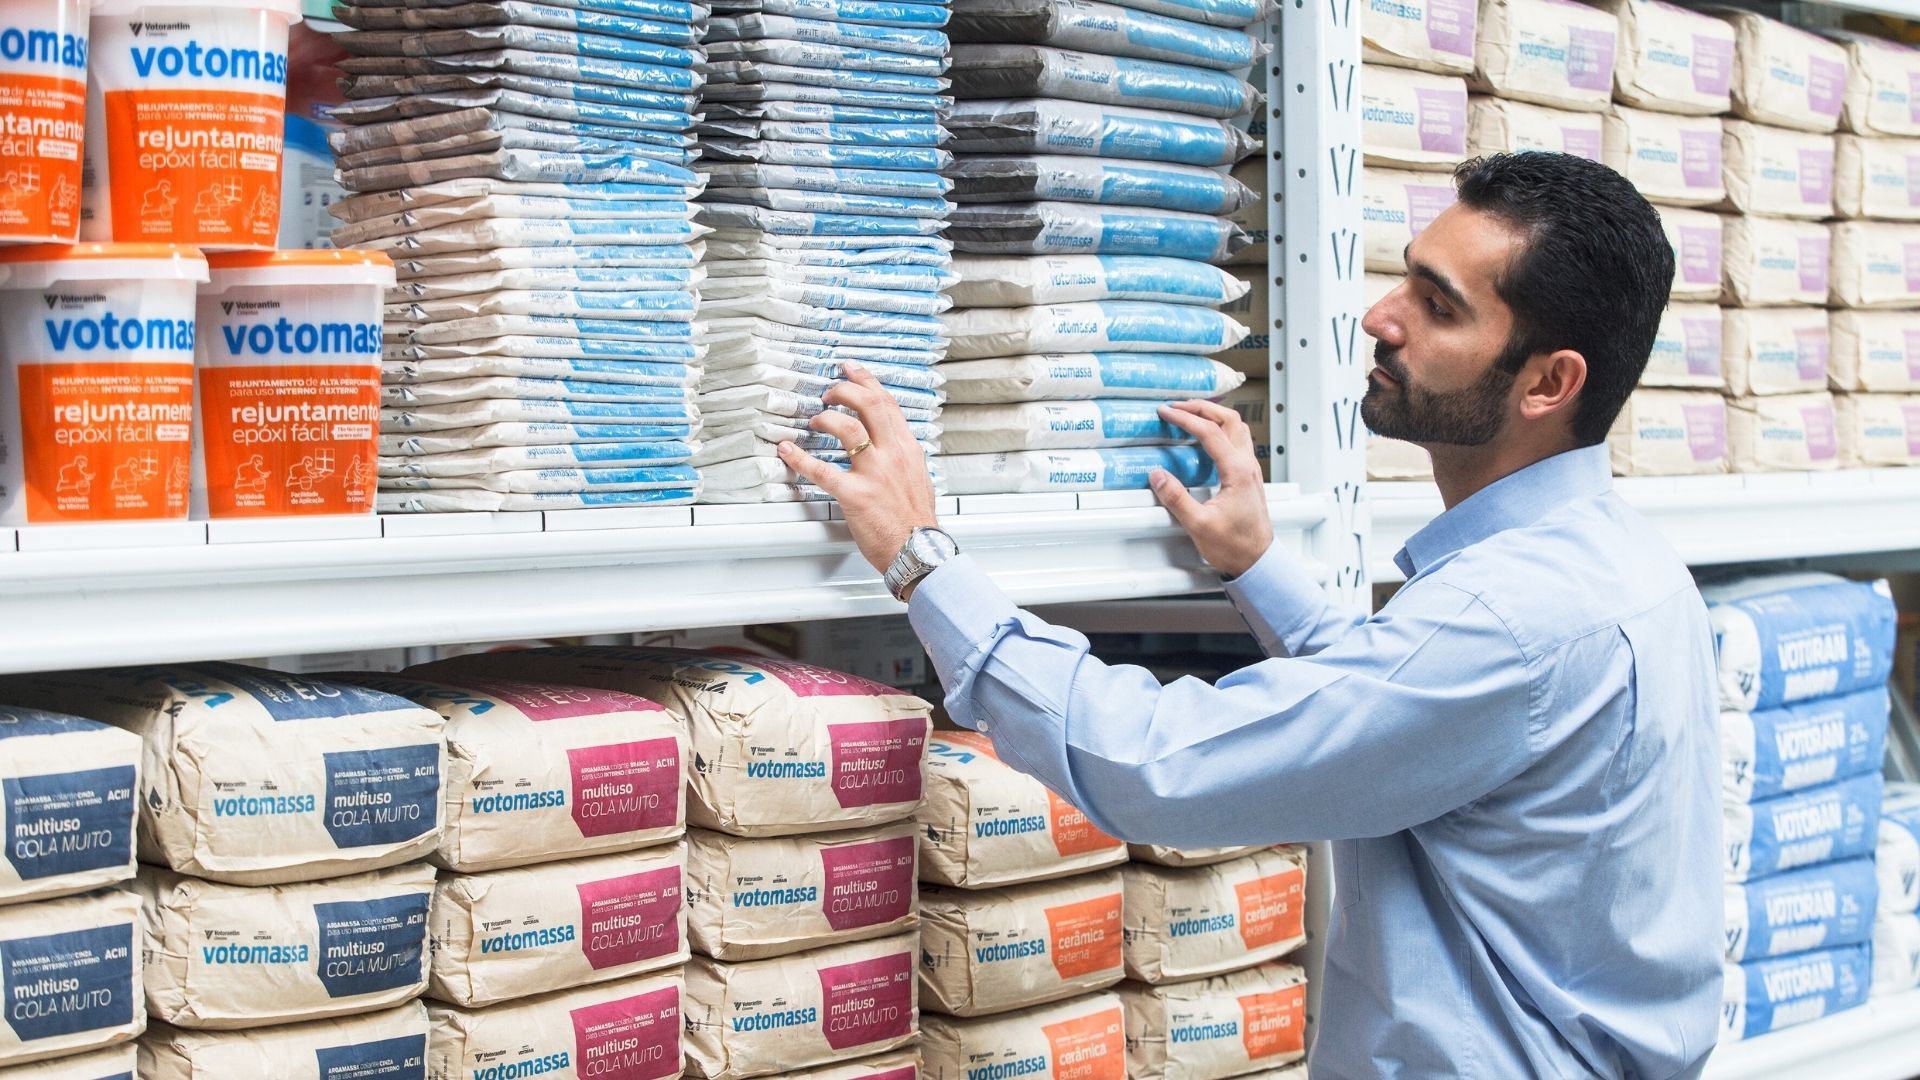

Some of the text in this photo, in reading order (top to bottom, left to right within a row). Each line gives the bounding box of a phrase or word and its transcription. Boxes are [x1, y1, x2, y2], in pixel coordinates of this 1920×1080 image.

[145, 22, 190, 31] Votorantim
[137, 103, 214, 112] REJUNTAMENTO
[137, 113, 162, 122] para
[163, 112, 183, 121] uso
[185, 112, 226, 121] INTERNO
[1362, 105, 1415, 126] votomassa
[1047, 134, 1095, 149] votomassa
[139, 150, 194, 172] epóxi
[200, 149, 237, 169] fácil
[1044, 233, 1093, 248] votomassa
[236, 301, 280, 310] Votorantim
[52, 386, 77, 395] para
[101, 385, 142, 394] INTERNO
[229, 379, 304, 388] REJUNTAMENTO
[305, 378, 318, 387] de
[230, 388, 253, 398] para
[255, 388, 275, 396] uso
[276, 387, 316, 396] INTERNO
[325, 387, 359, 395] EXTERNO
[231, 401, 379, 426] rejuntamento
[55, 423, 112, 447] epóxi
[116, 423, 153, 443] fácil
[232, 424, 287, 446] epóxi
[291, 422, 330, 442] fácil
[1049, 470, 1097, 484] votomassa
[603, 769, 624, 778] INTERNO
[610, 762, 630, 770] colante
[656, 757, 675, 769] ACIII
[747, 759, 826, 779] votomassa
[840, 758, 886, 772] multiuso
[582, 783, 634, 800] multiuso
[839, 774, 869, 790] COLA
[213, 793, 315, 817] votomassa
[334, 791, 392, 808] multiuso
[472, 789, 565, 813] votomassa
[581, 794, 659, 818] COLA MUITO
[332, 804, 420, 828] COLA MUITO
[975, 815, 1046, 838] votomassa
[15, 817, 81, 838] multiuso
[15, 829, 112, 859] COLA MUITO
[732, 886, 817, 908] votomassa
[833, 879, 878, 896] multiuso
[831, 889, 899, 913] COLA MUITO
[353, 926, 377, 935] INTERNO
[381, 922, 403, 931] EXTERNO
[591, 914, 641, 933] multiuso
[1169, 912, 1235, 938] votomassa
[481, 923, 575, 954] votomassa
[590, 923, 665, 951] COLA MUITO
[1058, 928, 1105, 950] cerâmica
[202, 942, 309, 964] votomassa
[327, 941, 385, 958] multiuso
[326, 959, 365, 978] COLA
[13, 978, 79, 1000] multiuso
[14, 988, 112, 1020] COLA MUITO
[831, 997, 875, 1016] multiuso
[732, 1006, 817, 1032] votomassa
[829, 1005, 898, 1033] COLA MUITO
[1170, 1020, 1238, 1043] votomassa
[586, 1037, 638, 1059] multiuso
[1059, 1042, 1108, 1066] cerâmica
[328, 1064, 359, 1074] ARGAMASSA
[473, 1051, 570, 1080] votomassa
[586, 1044, 663, 1077] COLA MUITO
[968, 1055, 1047, 1080] votomassa
[353, 1069, 374, 1078] INTERNO
[378, 1065, 400, 1075] EXTERNO
